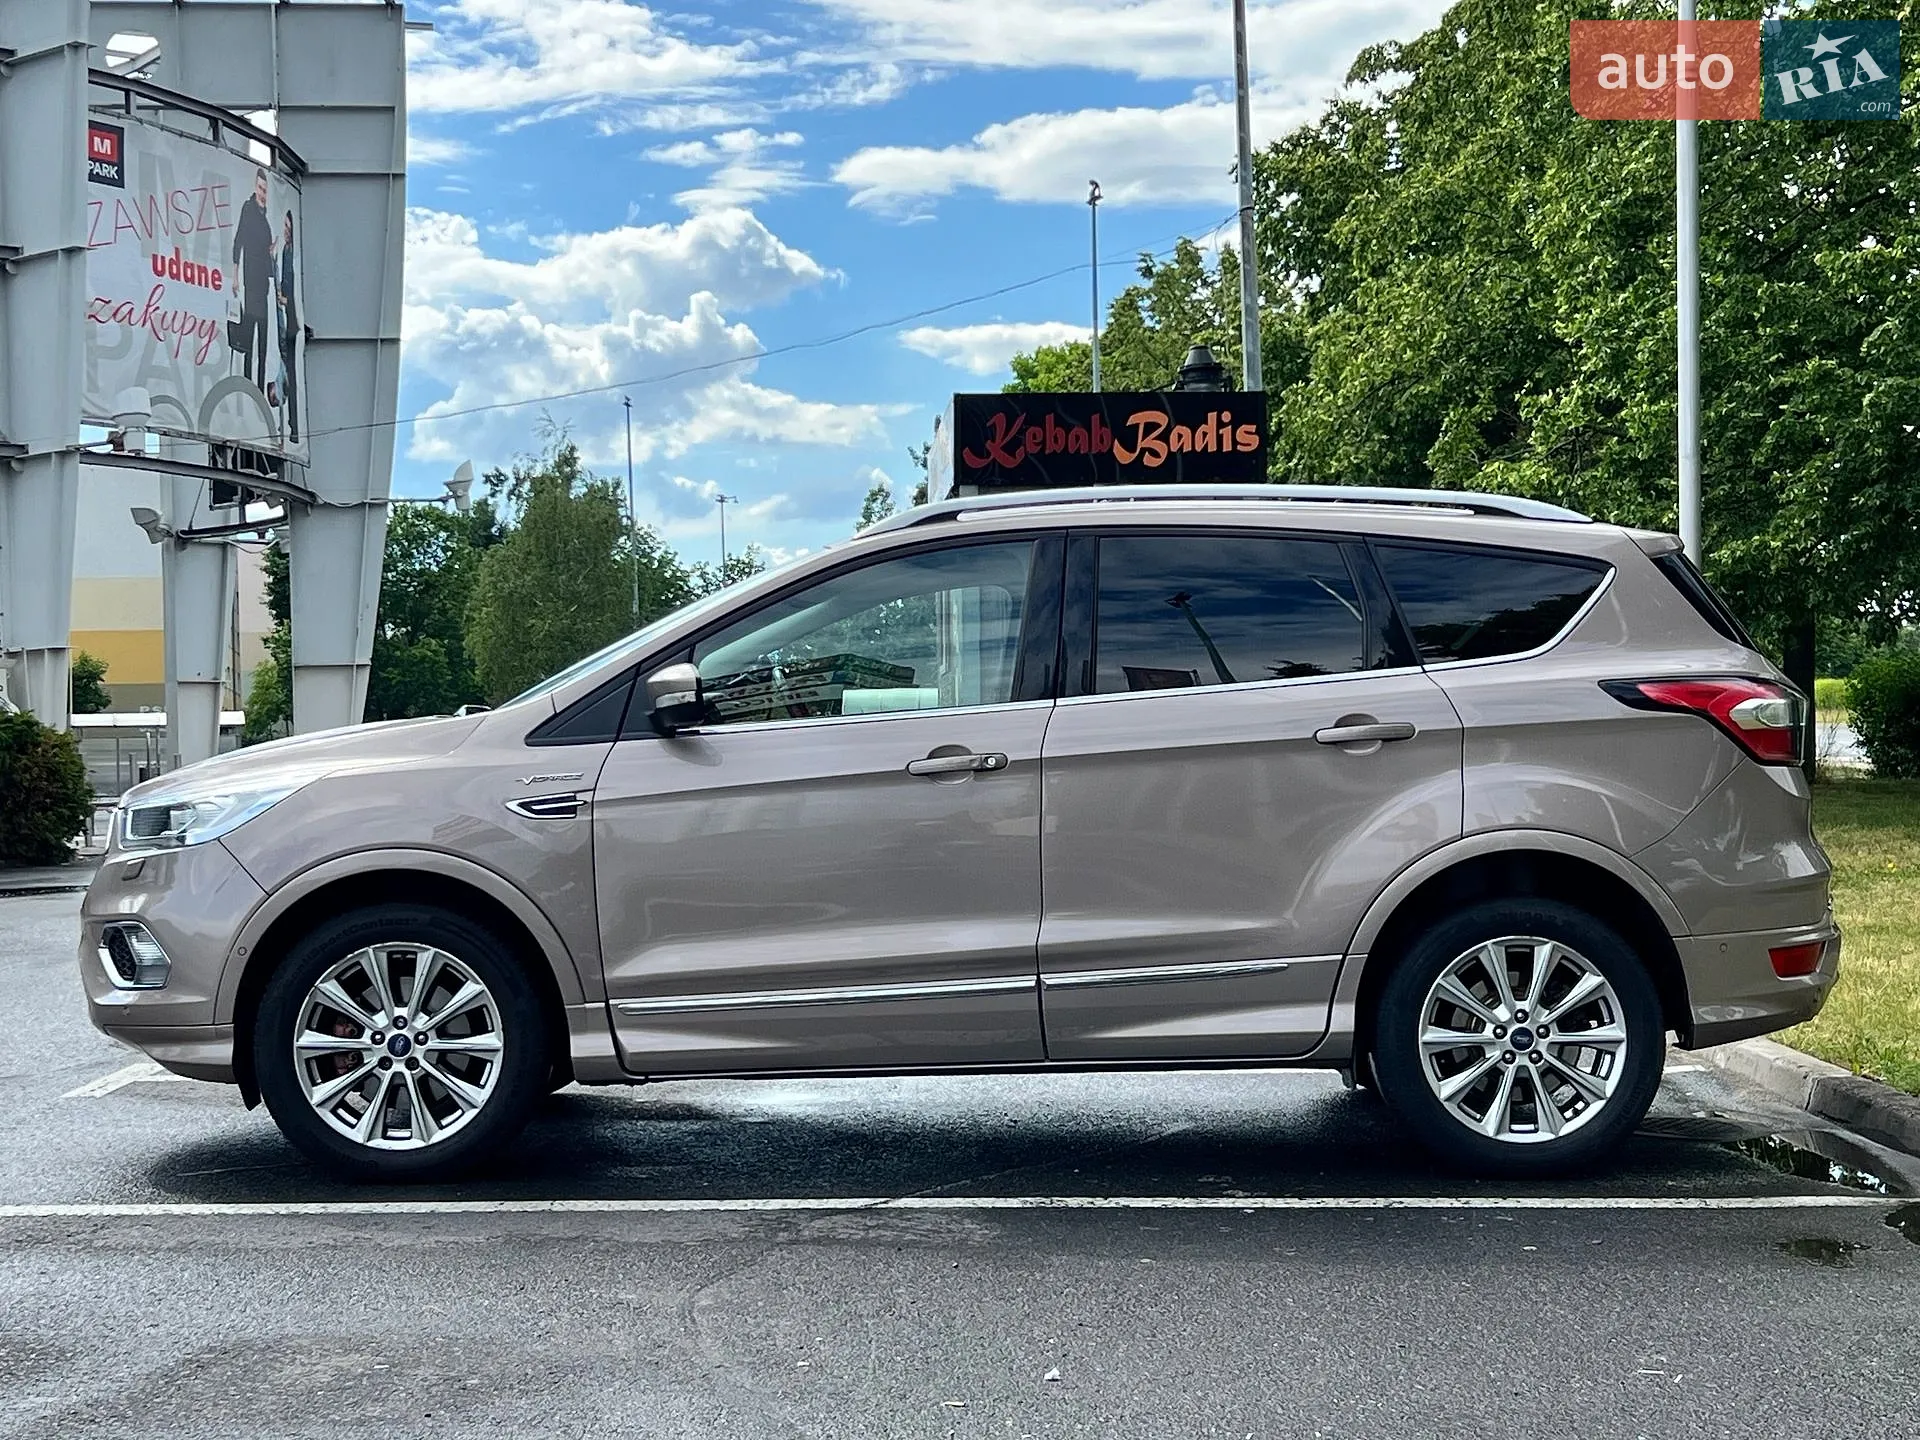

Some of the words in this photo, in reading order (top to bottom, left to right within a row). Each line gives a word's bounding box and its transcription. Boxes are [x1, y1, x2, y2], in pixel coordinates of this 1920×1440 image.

[88, 160, 119, 180] PARK
[93, 136, 112, 155] M
[87, 184, 234, 249] ZAWSZE
[152, 247, 223, 291] udane
[87, 284, 219, 366] zakupy
[963, 411, 1114, 469] Kebab
[1113, 410, 1260, 467] Badis
